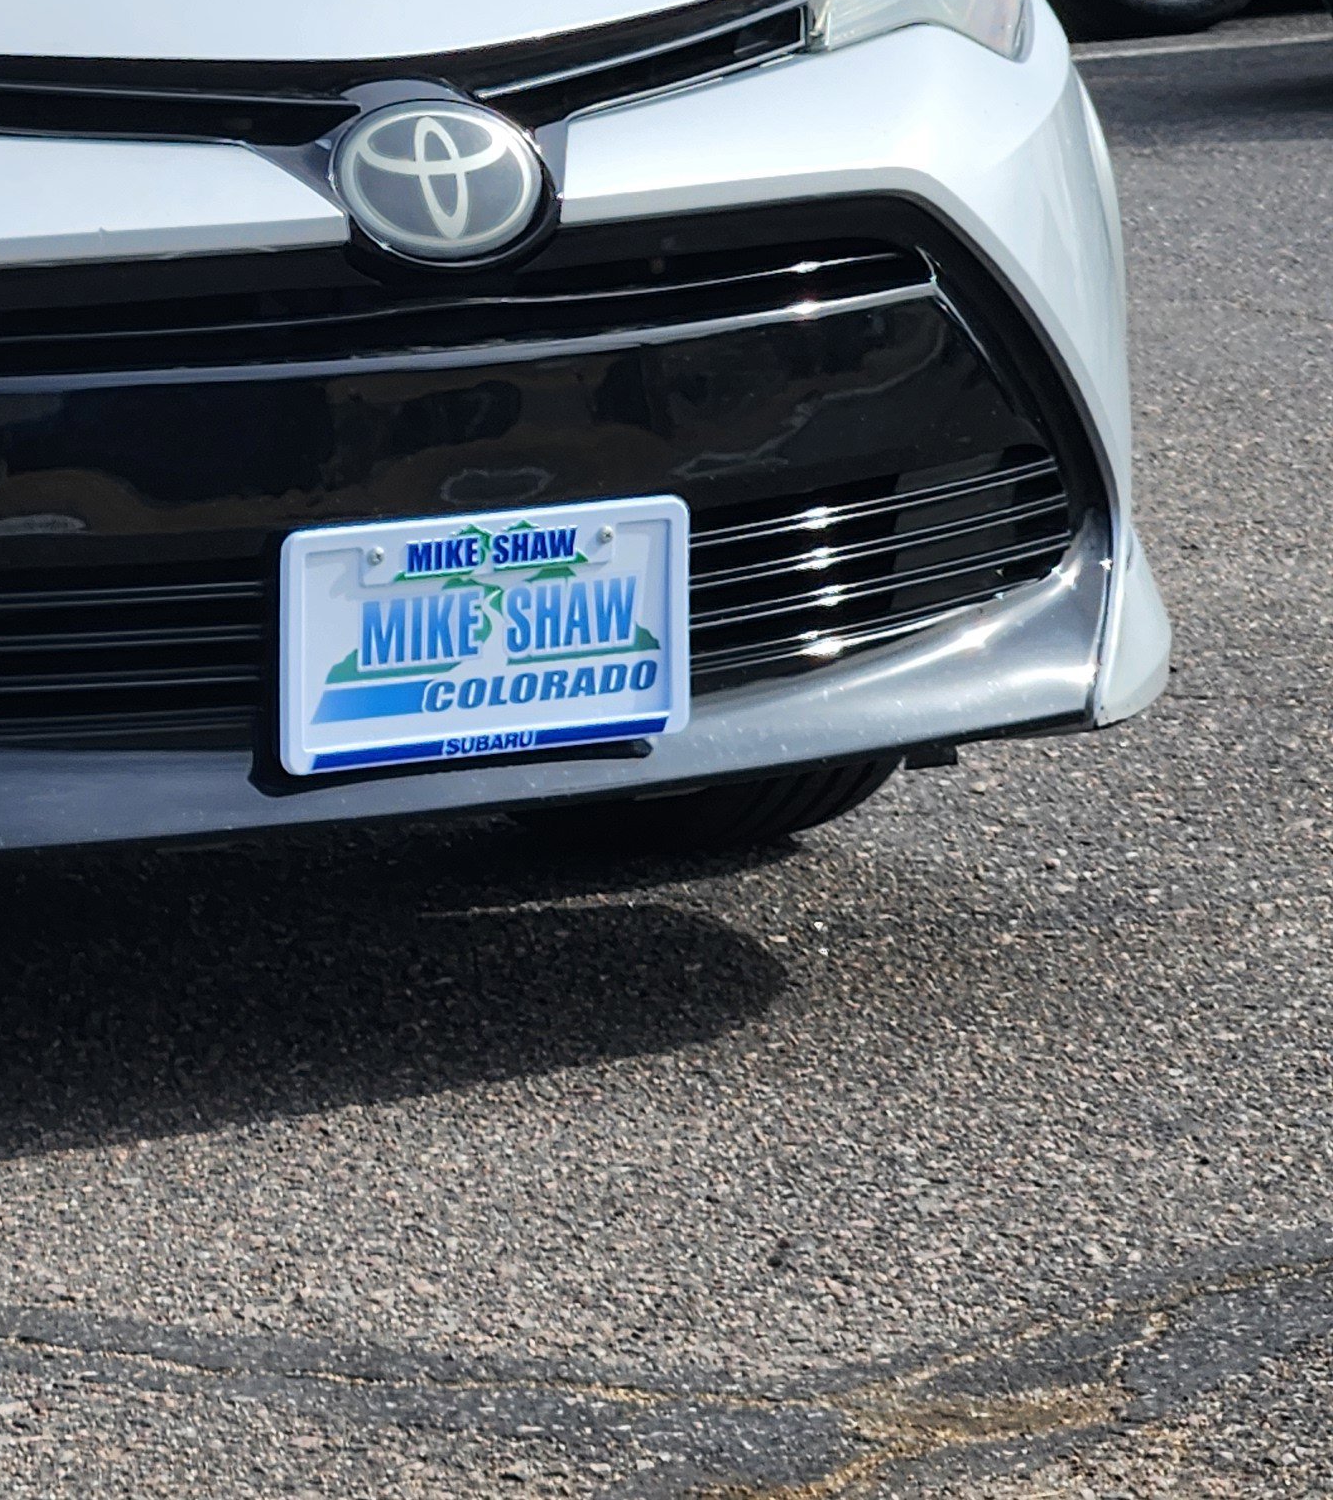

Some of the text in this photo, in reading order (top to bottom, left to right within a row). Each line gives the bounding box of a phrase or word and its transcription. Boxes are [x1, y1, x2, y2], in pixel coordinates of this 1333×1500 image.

[406, 525, 578, 574] MIKE SHAW
[361, 575, 637, 667] MIKE SHAW
[424, 660, 659, 714] COLORADO
[445, 731, 535, 756] SUBARU
